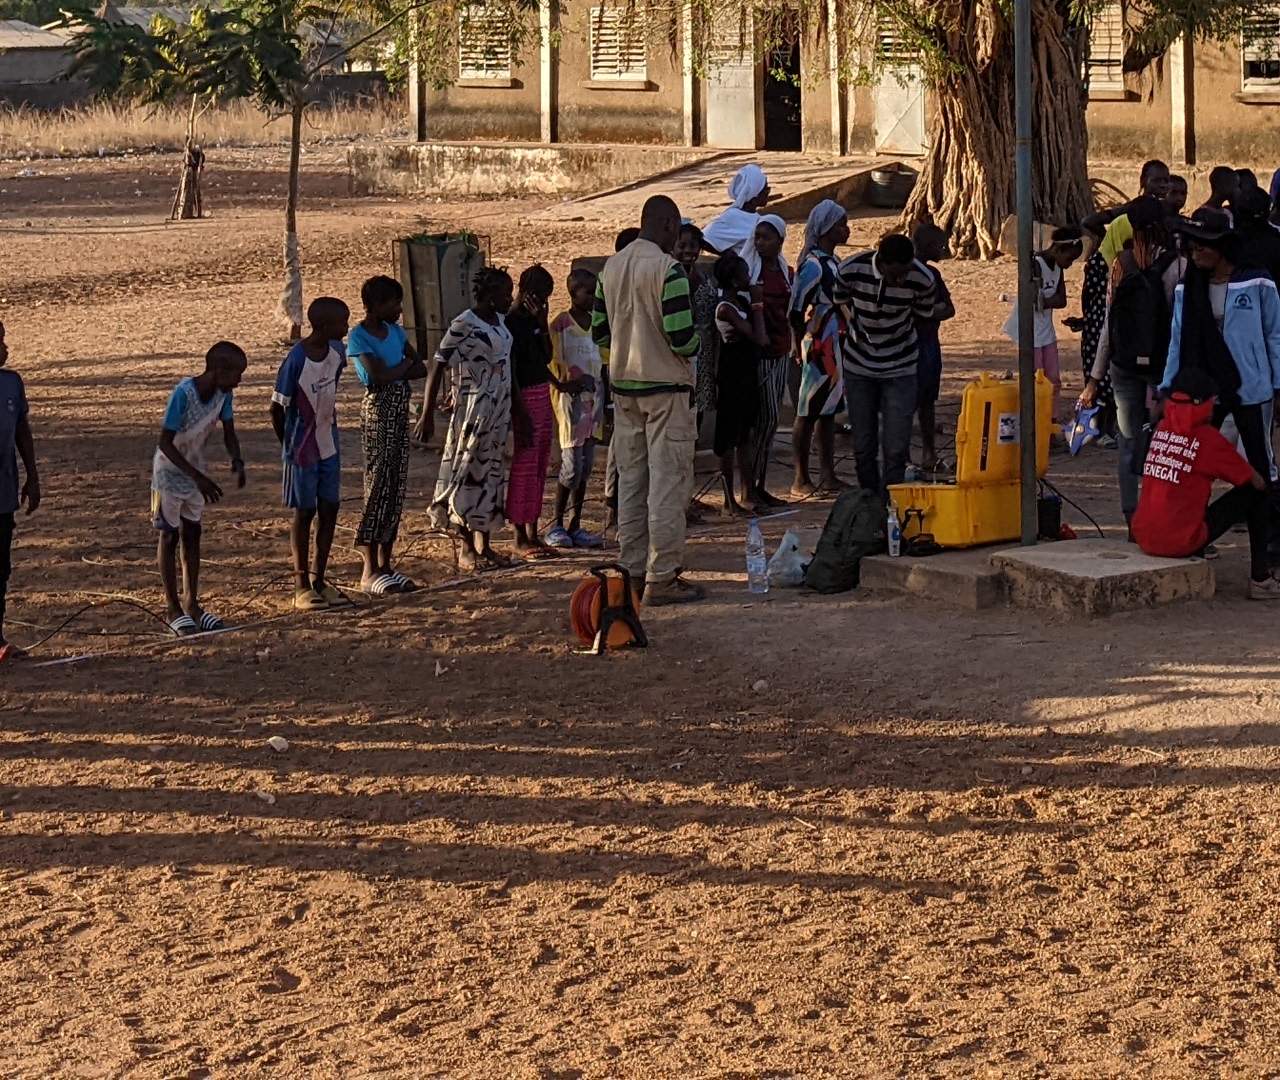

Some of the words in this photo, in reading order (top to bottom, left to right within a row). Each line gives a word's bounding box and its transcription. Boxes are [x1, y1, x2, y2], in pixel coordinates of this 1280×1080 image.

[1190, 438, 1200, 450] je
[1167, 444, 1183, 455] pour
[1183, 449, 1197, 460] une
